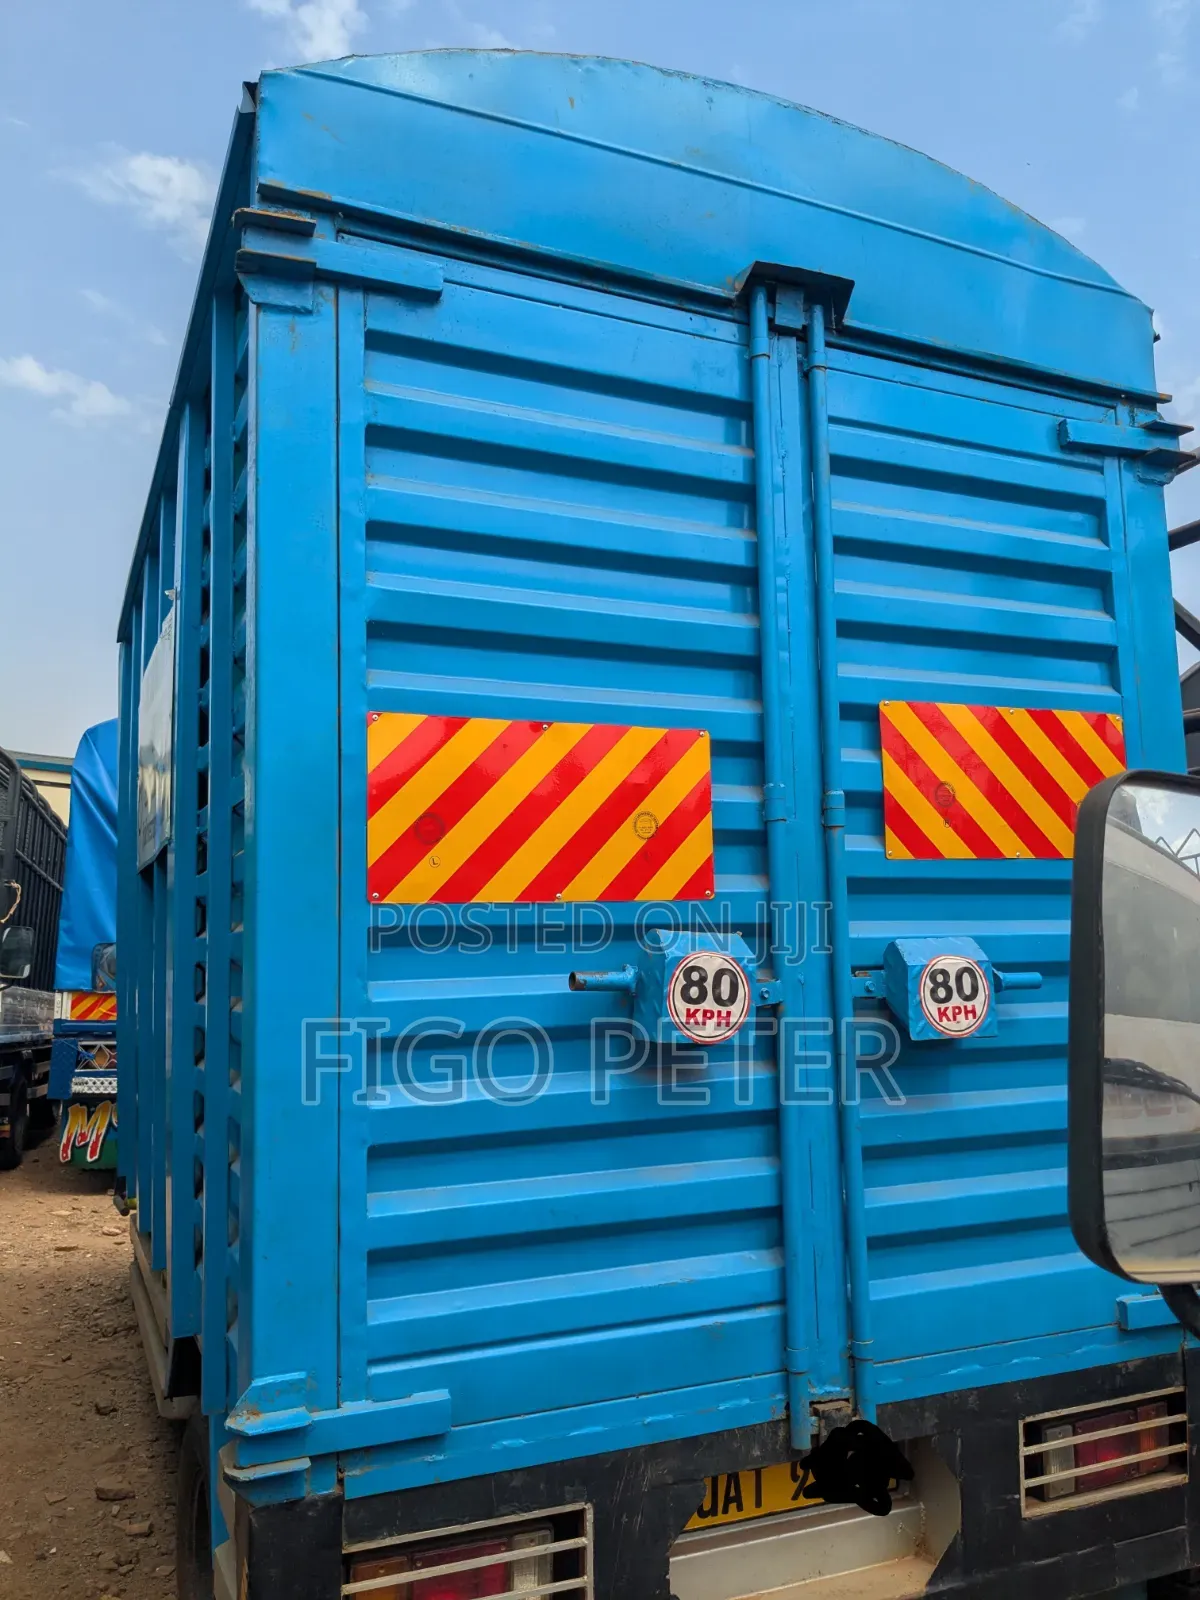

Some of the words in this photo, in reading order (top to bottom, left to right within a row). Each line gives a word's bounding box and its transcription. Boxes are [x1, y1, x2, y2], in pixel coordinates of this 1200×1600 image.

[680, 965, 739, 1007] 80
[928, 966, 980, 1004] 80
[685, 1007, 732, 1028] KPH
[937, 1005, 978, 1023] KPH
